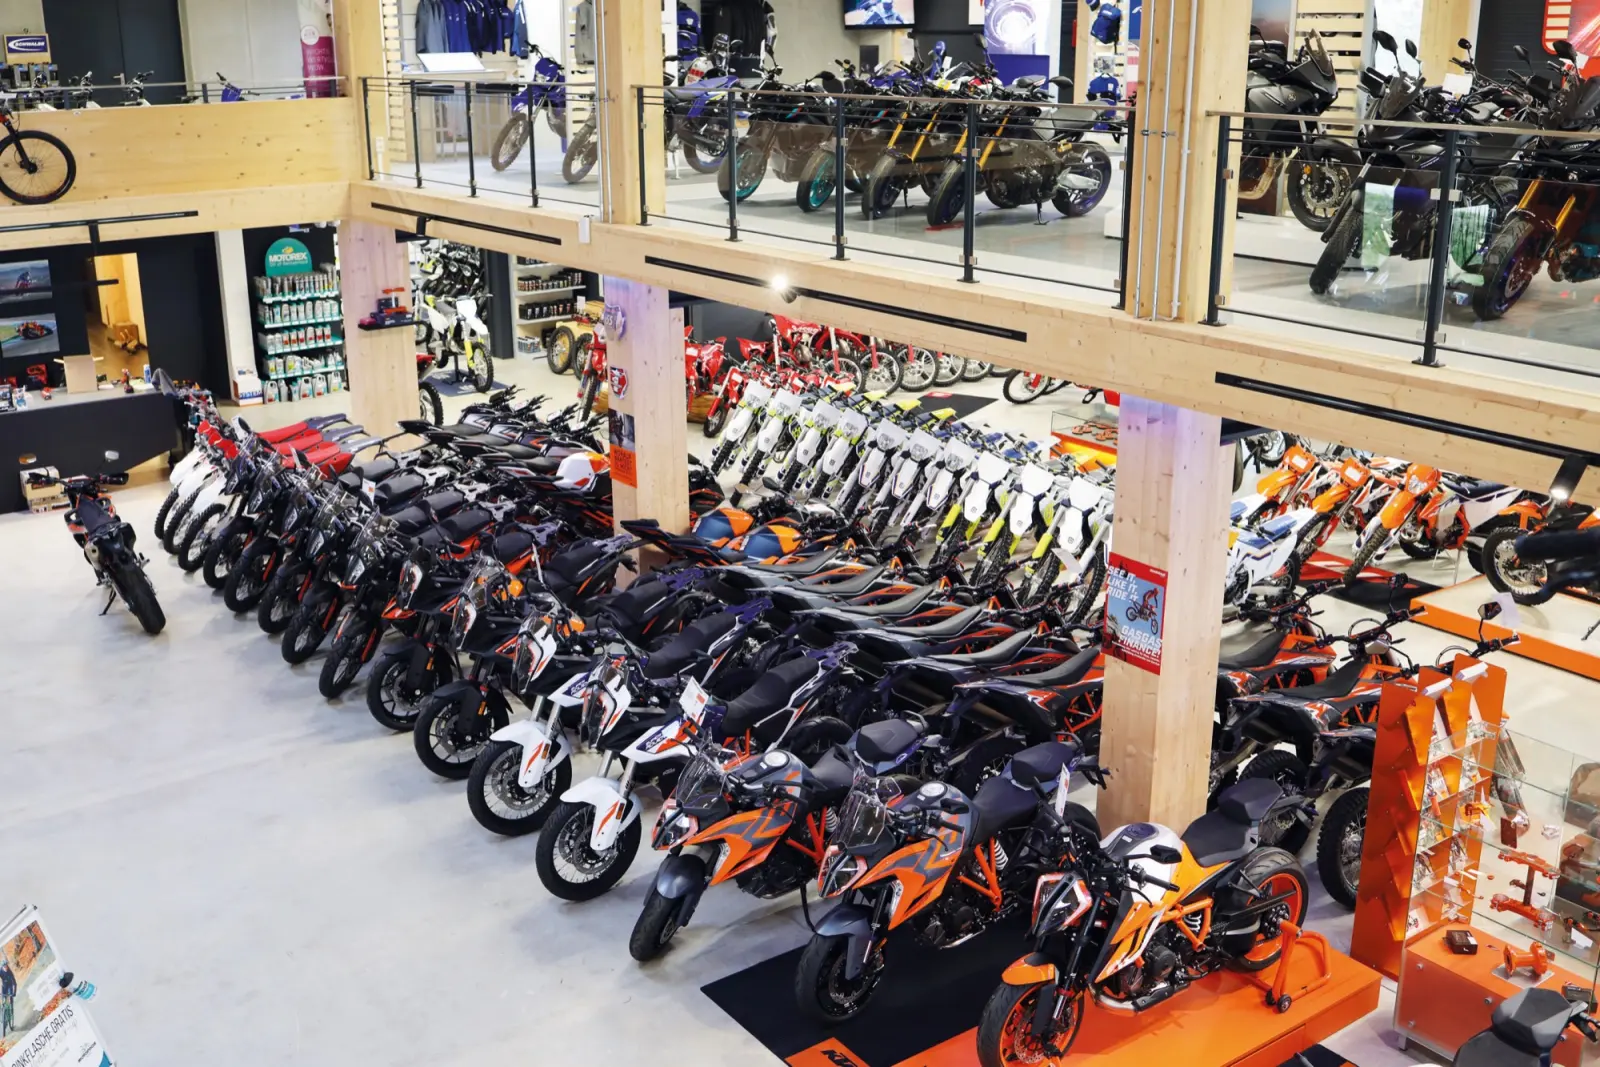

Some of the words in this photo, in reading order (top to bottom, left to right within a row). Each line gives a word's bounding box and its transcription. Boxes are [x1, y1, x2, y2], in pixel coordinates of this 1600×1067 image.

[269, 252, 307, 262] MOTOREX
[1108, 566, 1126, 578] SEE
[1107, 576, 1127, 590] LIKE
[1128, 583, 1138, 594] IT,
[1107, 586, 1128, 600] RIDE
[1122, 625, 1162, 647] GASGAS
[1118, 635, 1161, 658] FINANCE!
[50, 1004, 74, 1033] GRATIS
